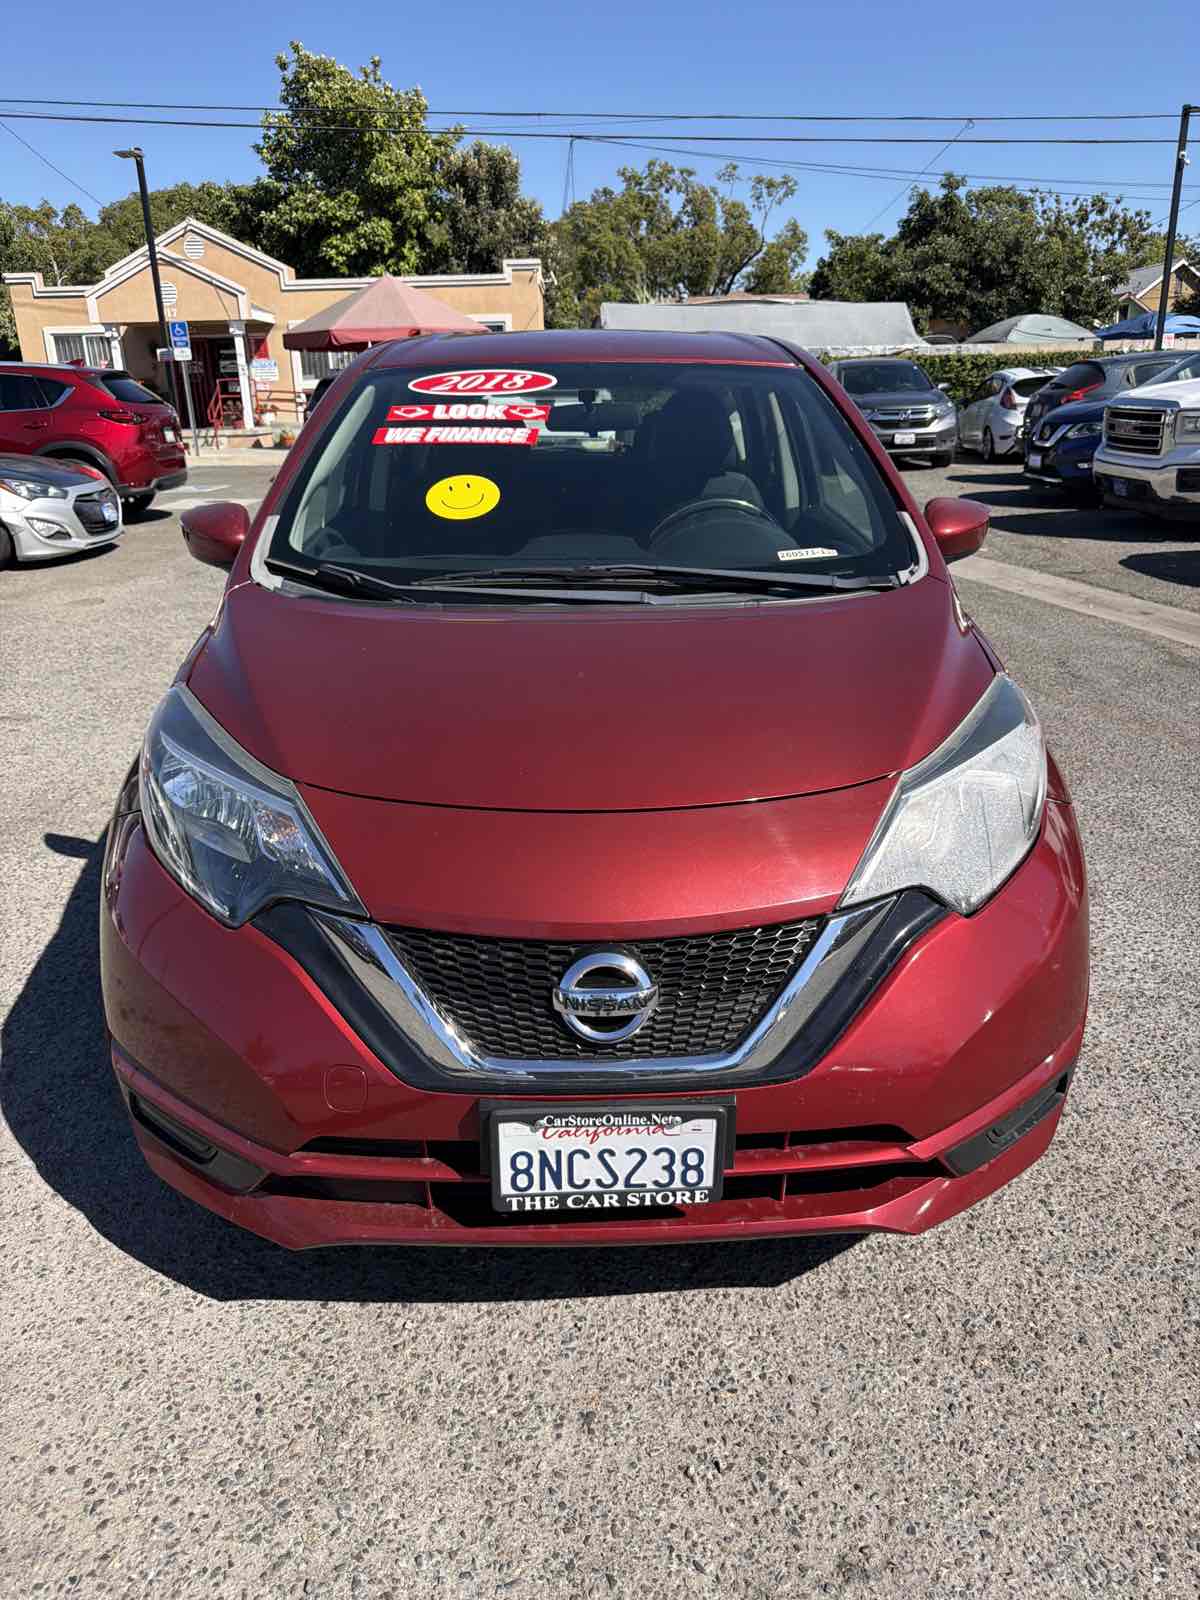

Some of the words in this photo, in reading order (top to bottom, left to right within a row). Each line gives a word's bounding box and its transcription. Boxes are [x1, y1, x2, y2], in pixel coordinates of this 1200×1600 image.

[430, 374, 532, 391] 2018
[432, 404, 509, 420] LOOK
[384, 427, 421, 443] WE
[425, 427, 530, 443] FINANCE
[563, 994, 653, 1012] NISSAN
[543, 1114, 674, 1127] CarStoreOnline.Net
[542, 1124, 680, 1144] California
[510, 1148, 705, 1192] 8NCS238
[506, 1196, 559, 1211] THE
[567, 1192, 620, 1208] CAR
[626, 1189, 710, 1205] STORE
